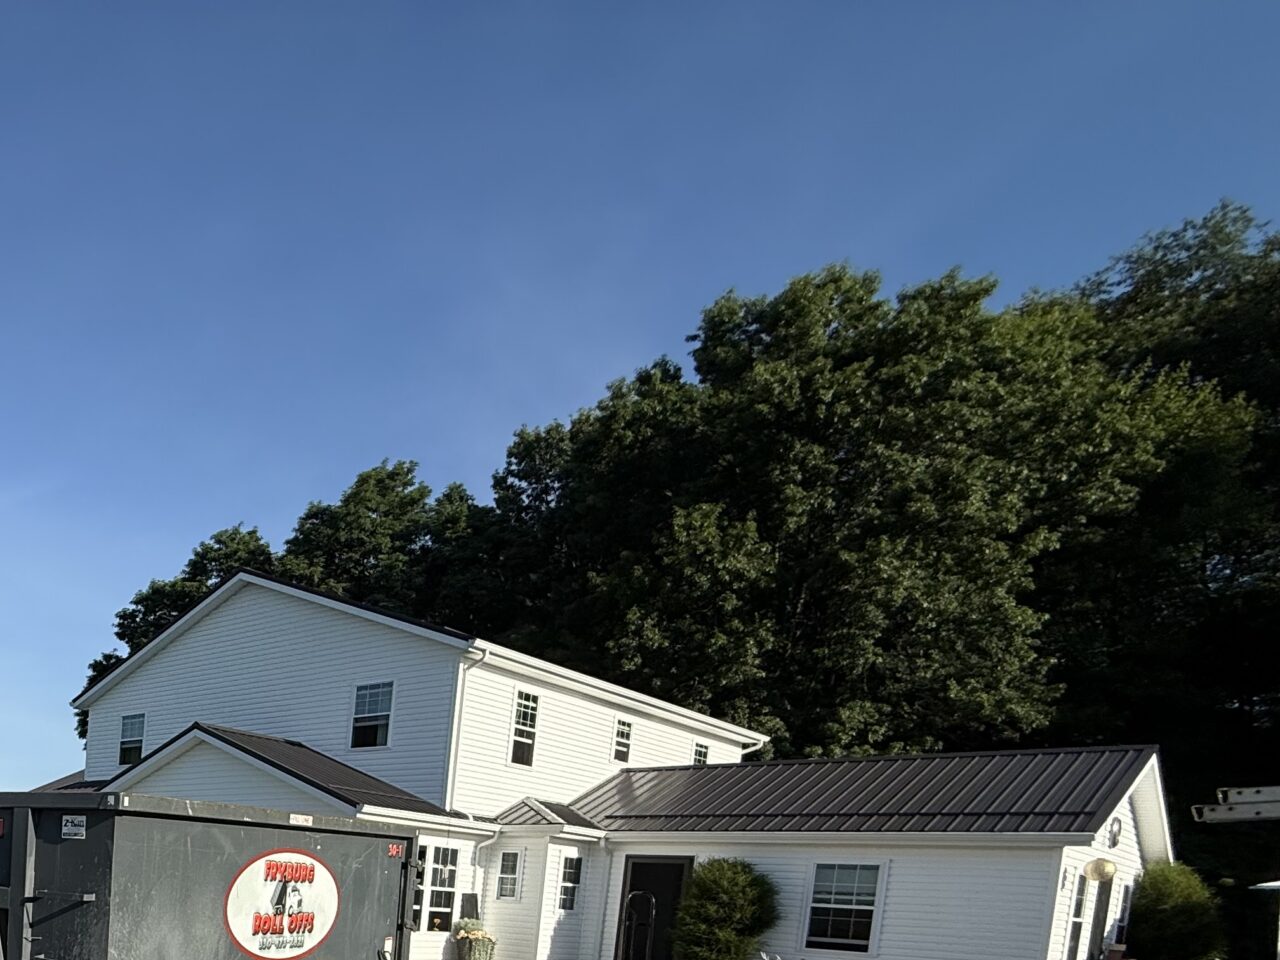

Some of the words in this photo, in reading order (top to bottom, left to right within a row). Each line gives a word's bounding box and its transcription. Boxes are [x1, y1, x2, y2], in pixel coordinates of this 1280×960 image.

[388, 843, 402, 858] 30-1
[264, 860, 315, 883] FRYBURG
[252, 912, 284, 935] ROLL
[287, 912, 315, 934] OFFS
